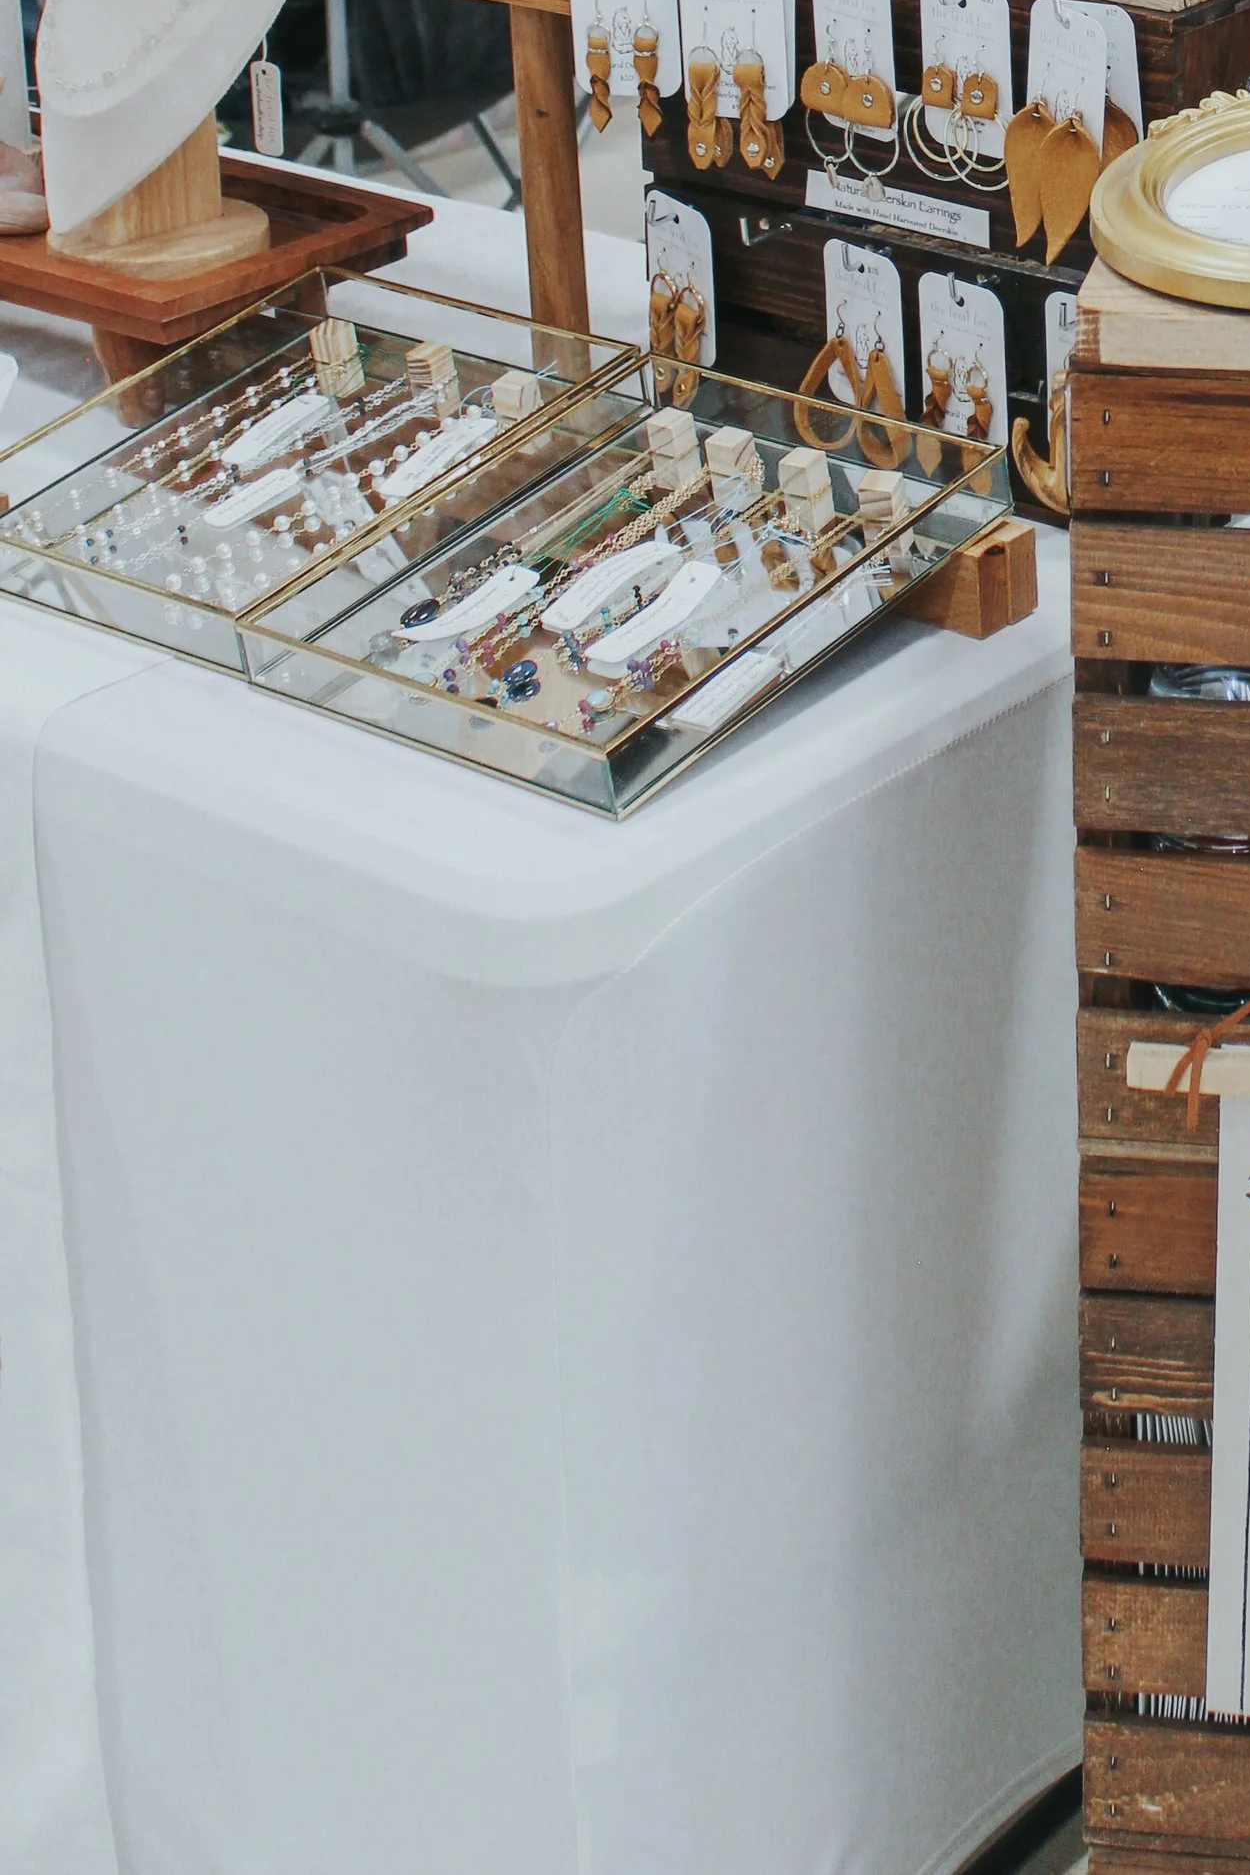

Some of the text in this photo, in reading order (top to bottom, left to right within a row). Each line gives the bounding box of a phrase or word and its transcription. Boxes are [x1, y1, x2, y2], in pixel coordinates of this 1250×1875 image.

[834, 199, 854, 212] Made
[856, 205, 871, 216] with
[872, 209, 891, 221] Hand
[893, 214, 928, 229] Harvested
[836, 181, 865, 197] atura
[919, 201, 962, 224] Earrings
